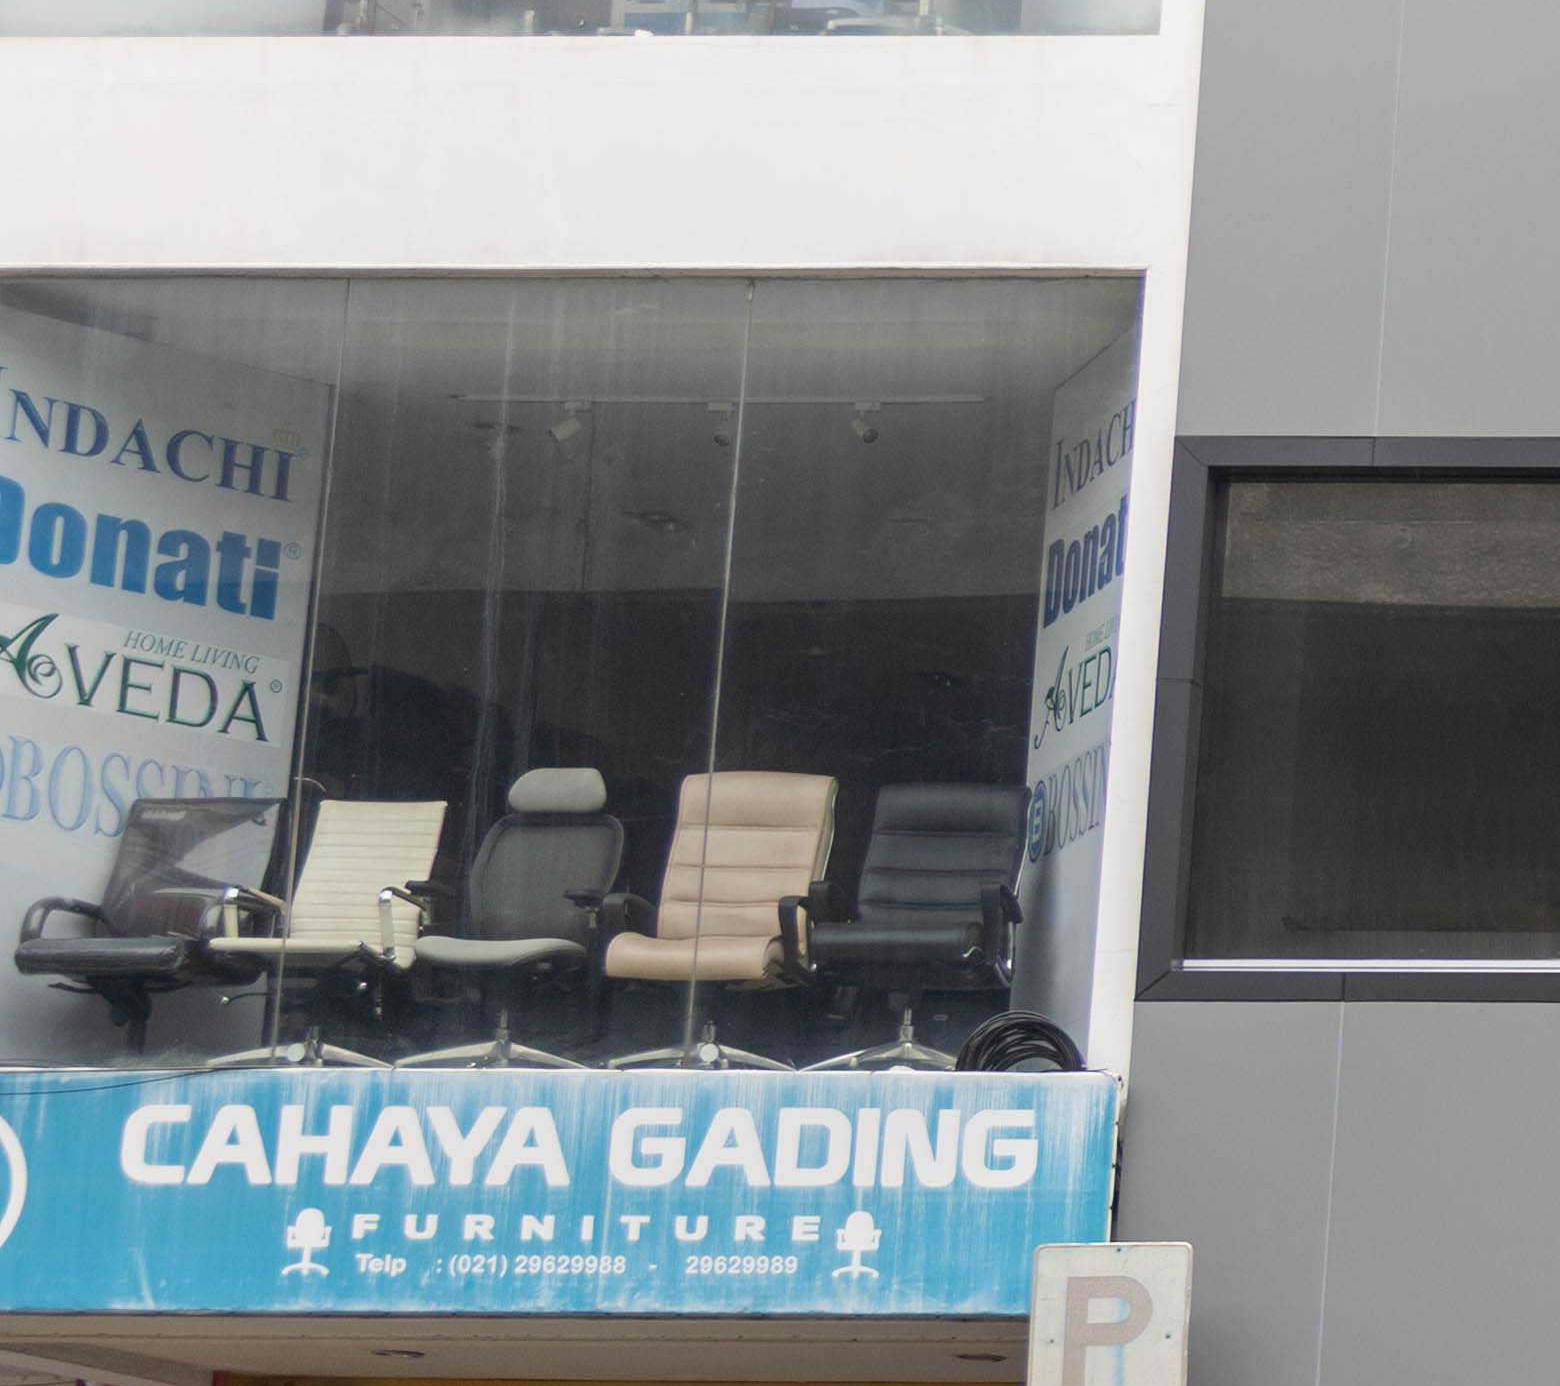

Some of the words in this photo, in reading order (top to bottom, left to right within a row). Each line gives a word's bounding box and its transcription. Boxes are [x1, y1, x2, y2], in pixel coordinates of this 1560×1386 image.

[123, 629, 187, 662] HOME
[189, 642, 260, 676] LIVING
[120, 1103, 568, 1187] CAHAYA
[609, 1104, 1038, 1190] GADING
[351, 1212, 823, 1243] FURNITURE
[356, 1254, 406, 1277] Telp
[449, 1253, 508, 1278] (021)
[514, 1254, 627, 1276] 29629988
[685, 1254, 799, 1276] 29629989
